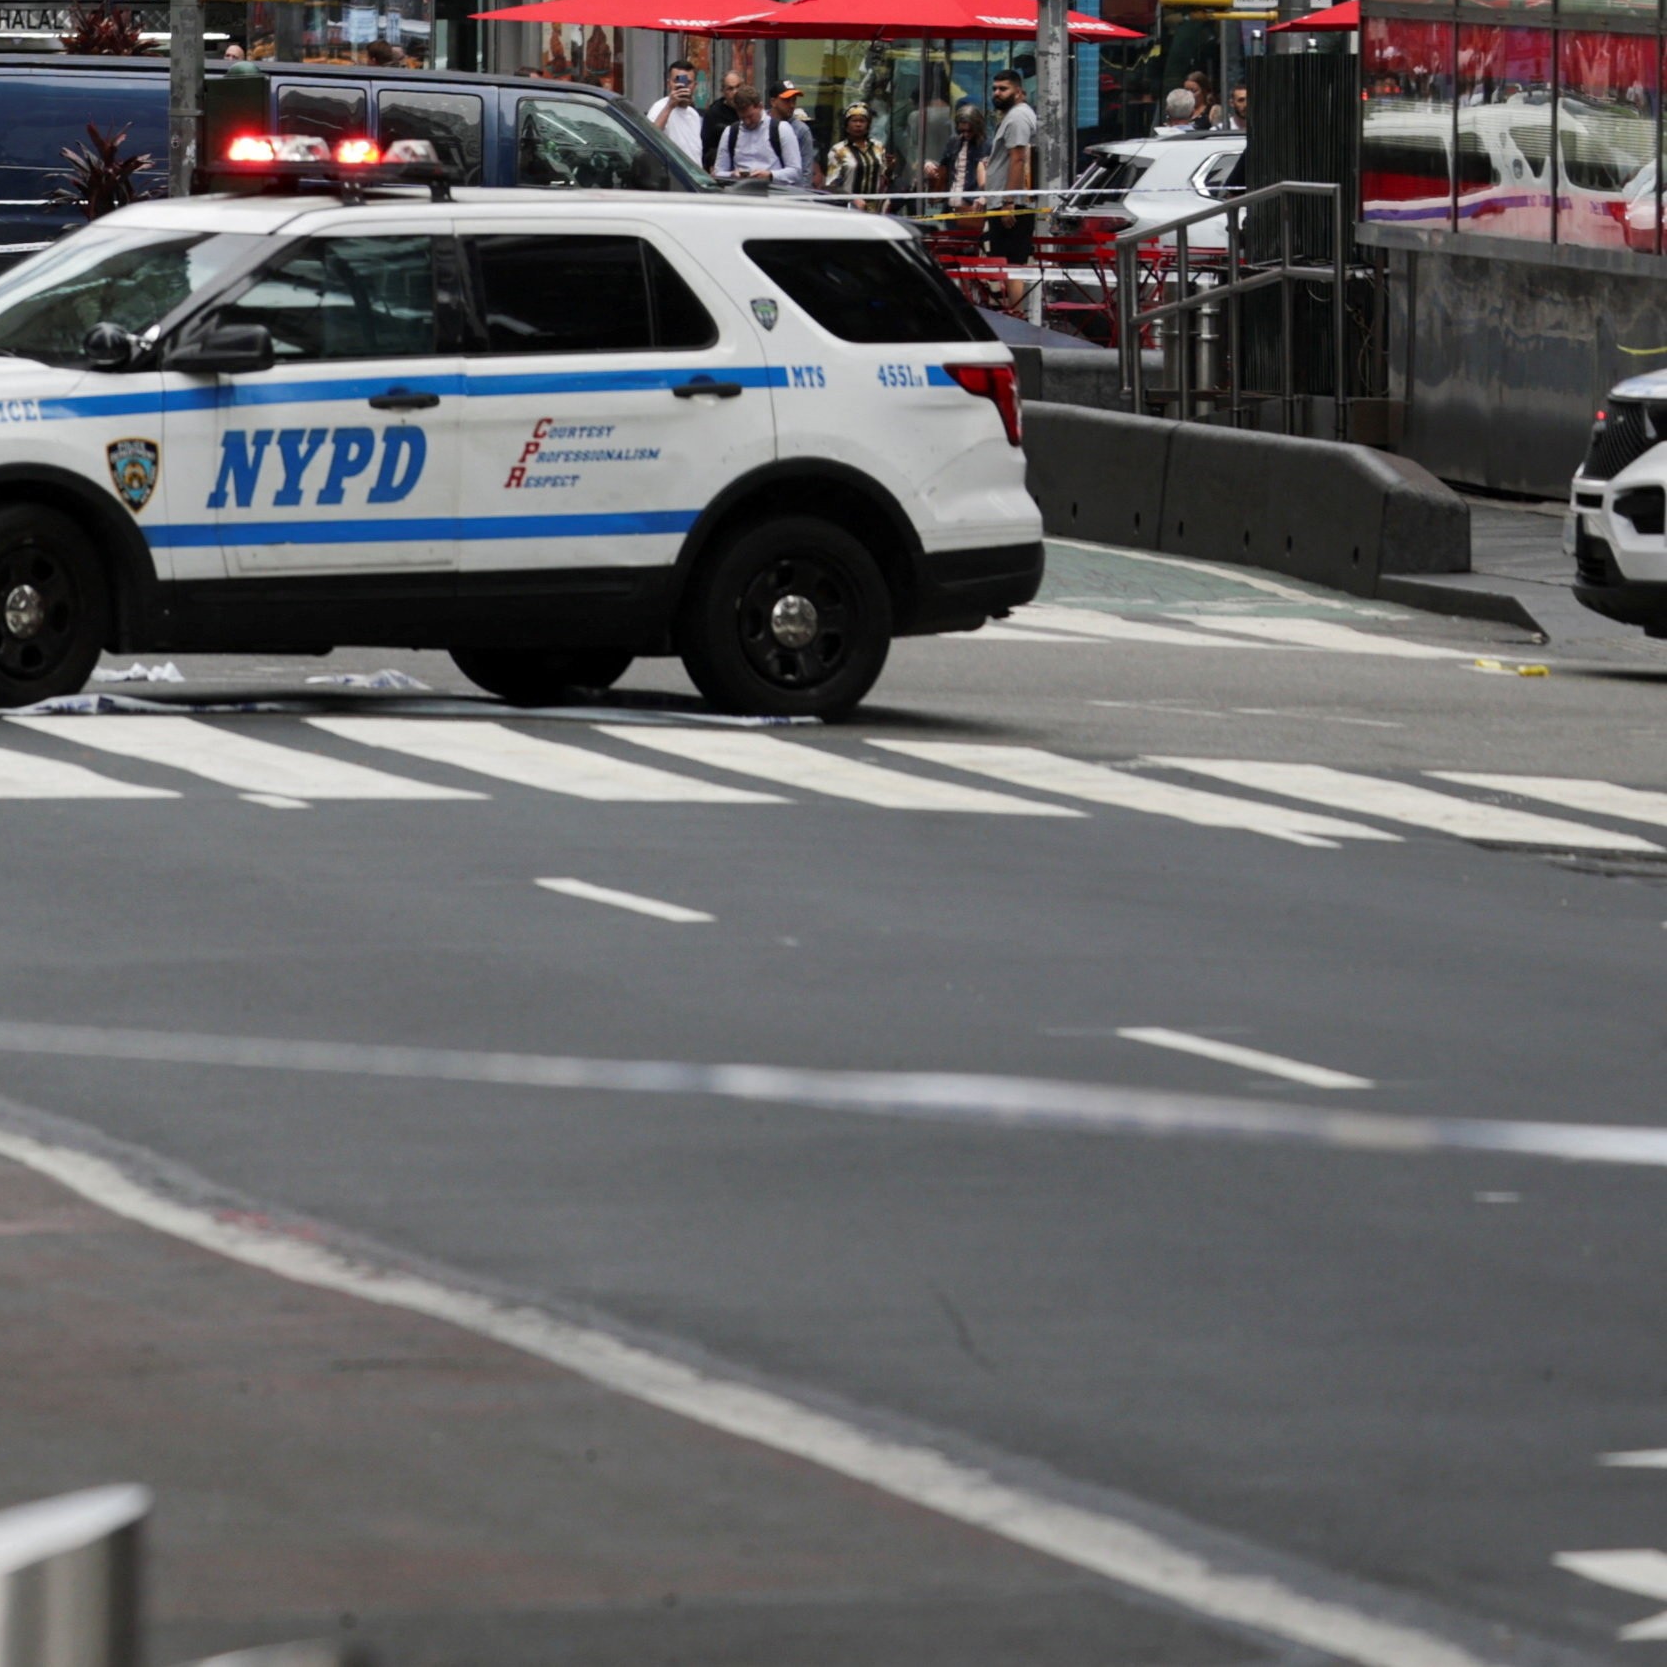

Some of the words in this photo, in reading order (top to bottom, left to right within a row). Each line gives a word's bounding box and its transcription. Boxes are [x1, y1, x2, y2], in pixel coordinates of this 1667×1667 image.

[791, 365, 826, 389] MTS
[877, 364, 917, 388] 4551
[533, 419, 616, 440] COURTESY
[519, 442, 661, 464] PROFESSIONALISM
[207, 426, 427, 508] NYPD
[504, 466, 581, 489] RESPECT
